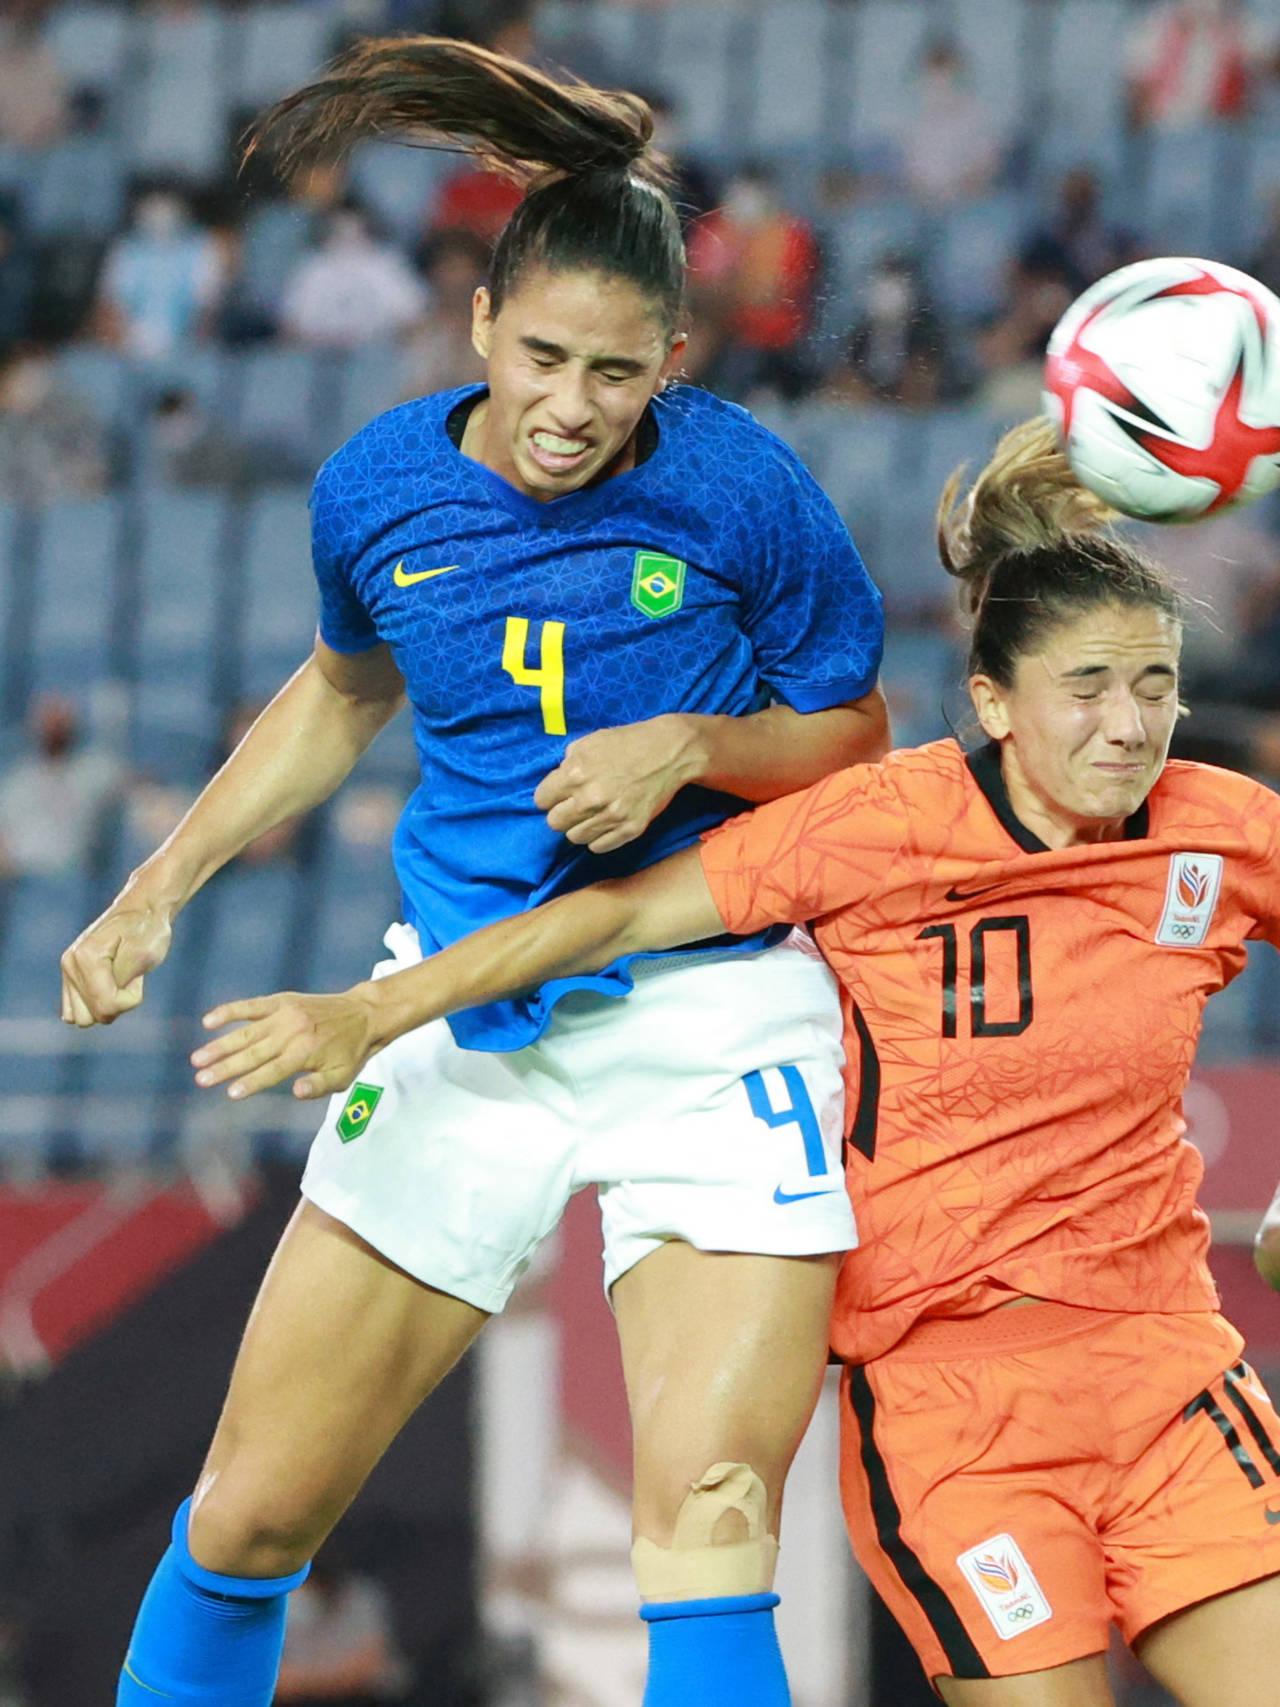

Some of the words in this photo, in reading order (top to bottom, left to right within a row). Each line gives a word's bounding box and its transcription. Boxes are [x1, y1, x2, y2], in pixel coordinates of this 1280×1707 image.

[502, 616, 567, 735] 4
[914, 914, 1034, 1039] 10
[740, 1065, 828, 1177] 4
